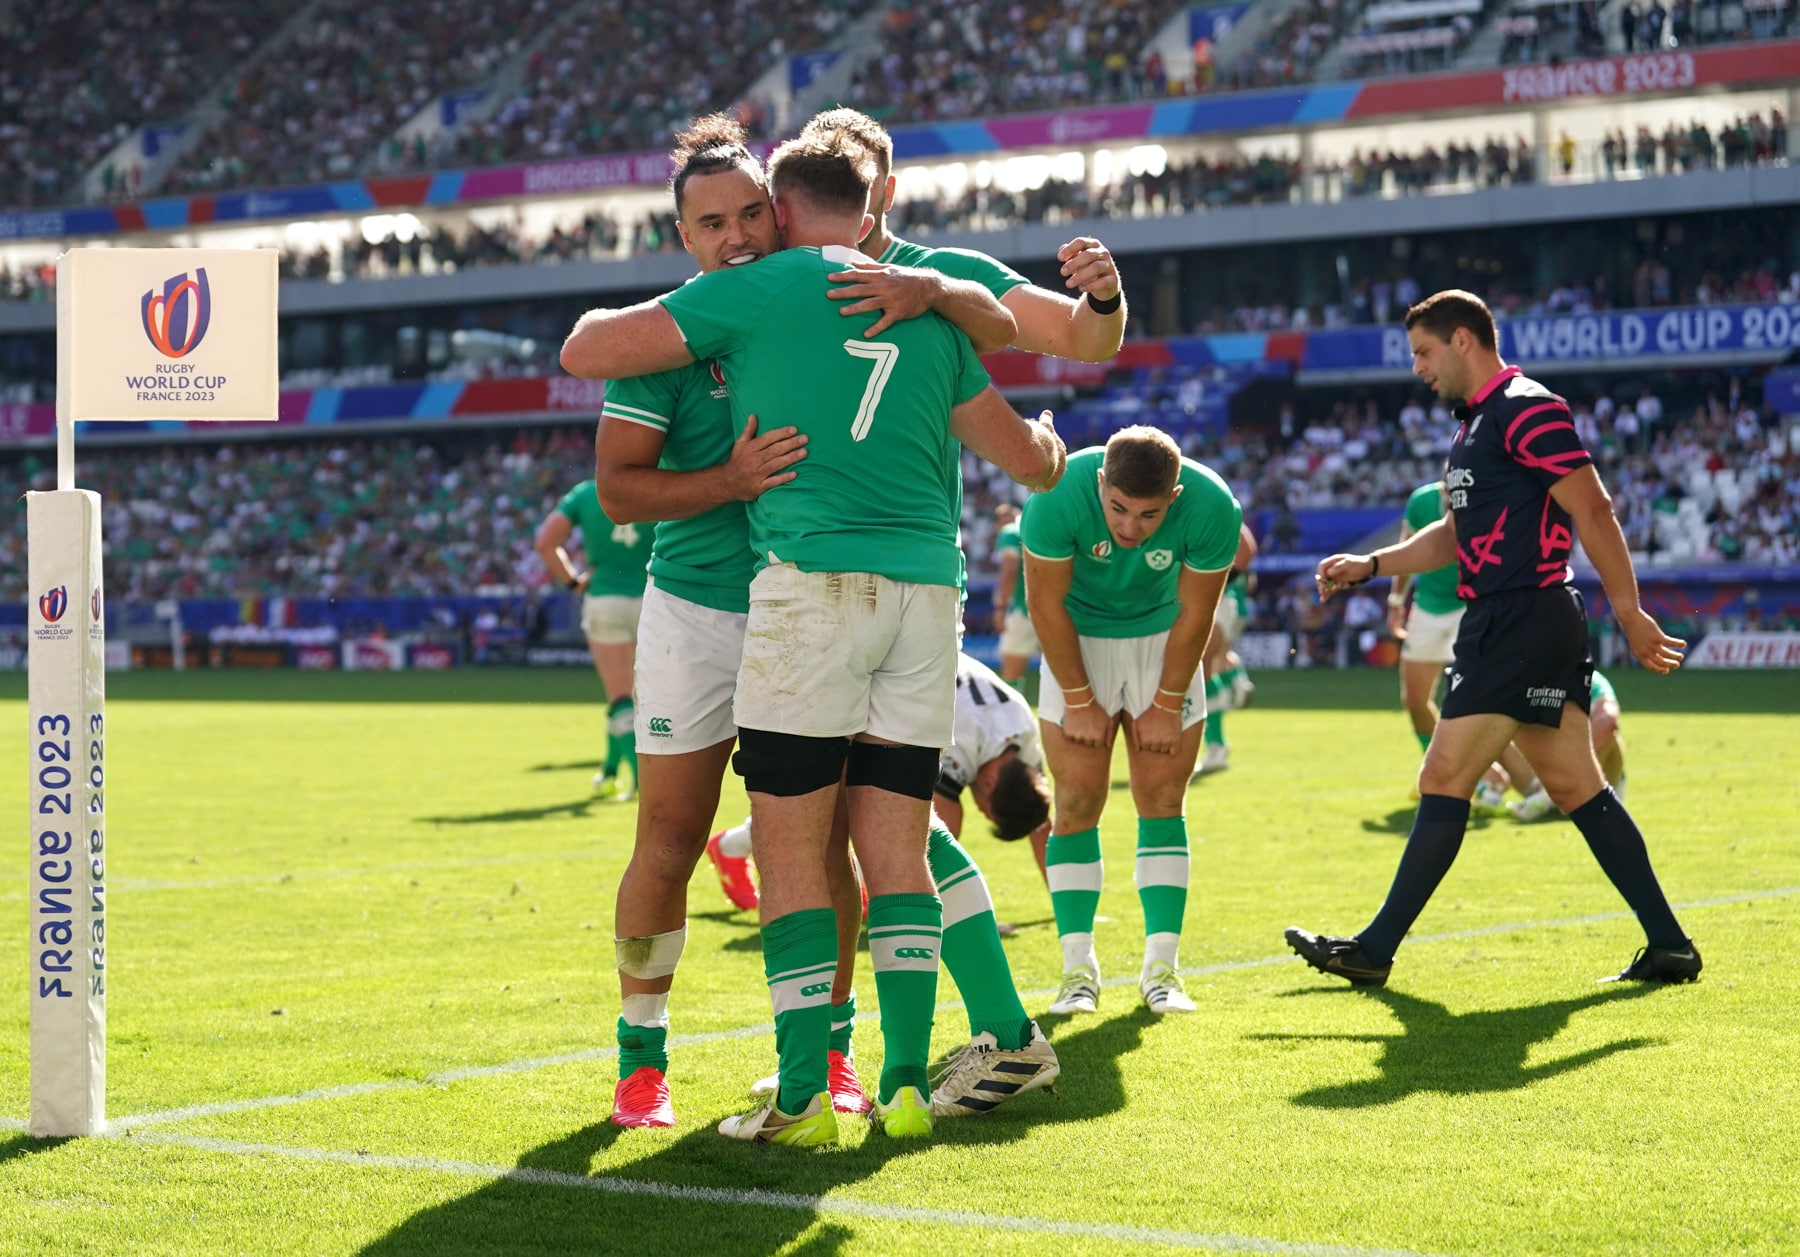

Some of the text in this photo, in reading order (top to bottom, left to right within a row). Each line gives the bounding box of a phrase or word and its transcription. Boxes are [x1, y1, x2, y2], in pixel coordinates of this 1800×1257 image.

[1622, 53, 1696, 92] 2023
[1513, 314, 1646, 358] WORLD
[1657, 310, 1732, 352] CUP
[155, 364, 195, 374] RUGBY
[126, 376, 227, 389] WORLD CUP
[843, 339, 900, 442] 7
[137, 392, 215, 401] FRANCE 2023
[610, 523, 641, 548] 4
[1526, 686, 1567, 699] Emirates
[1540, 697, 1562, 708] BETTER
[38, 713, 72, 814] 2023
[90, 713, 104, 813] 2023
